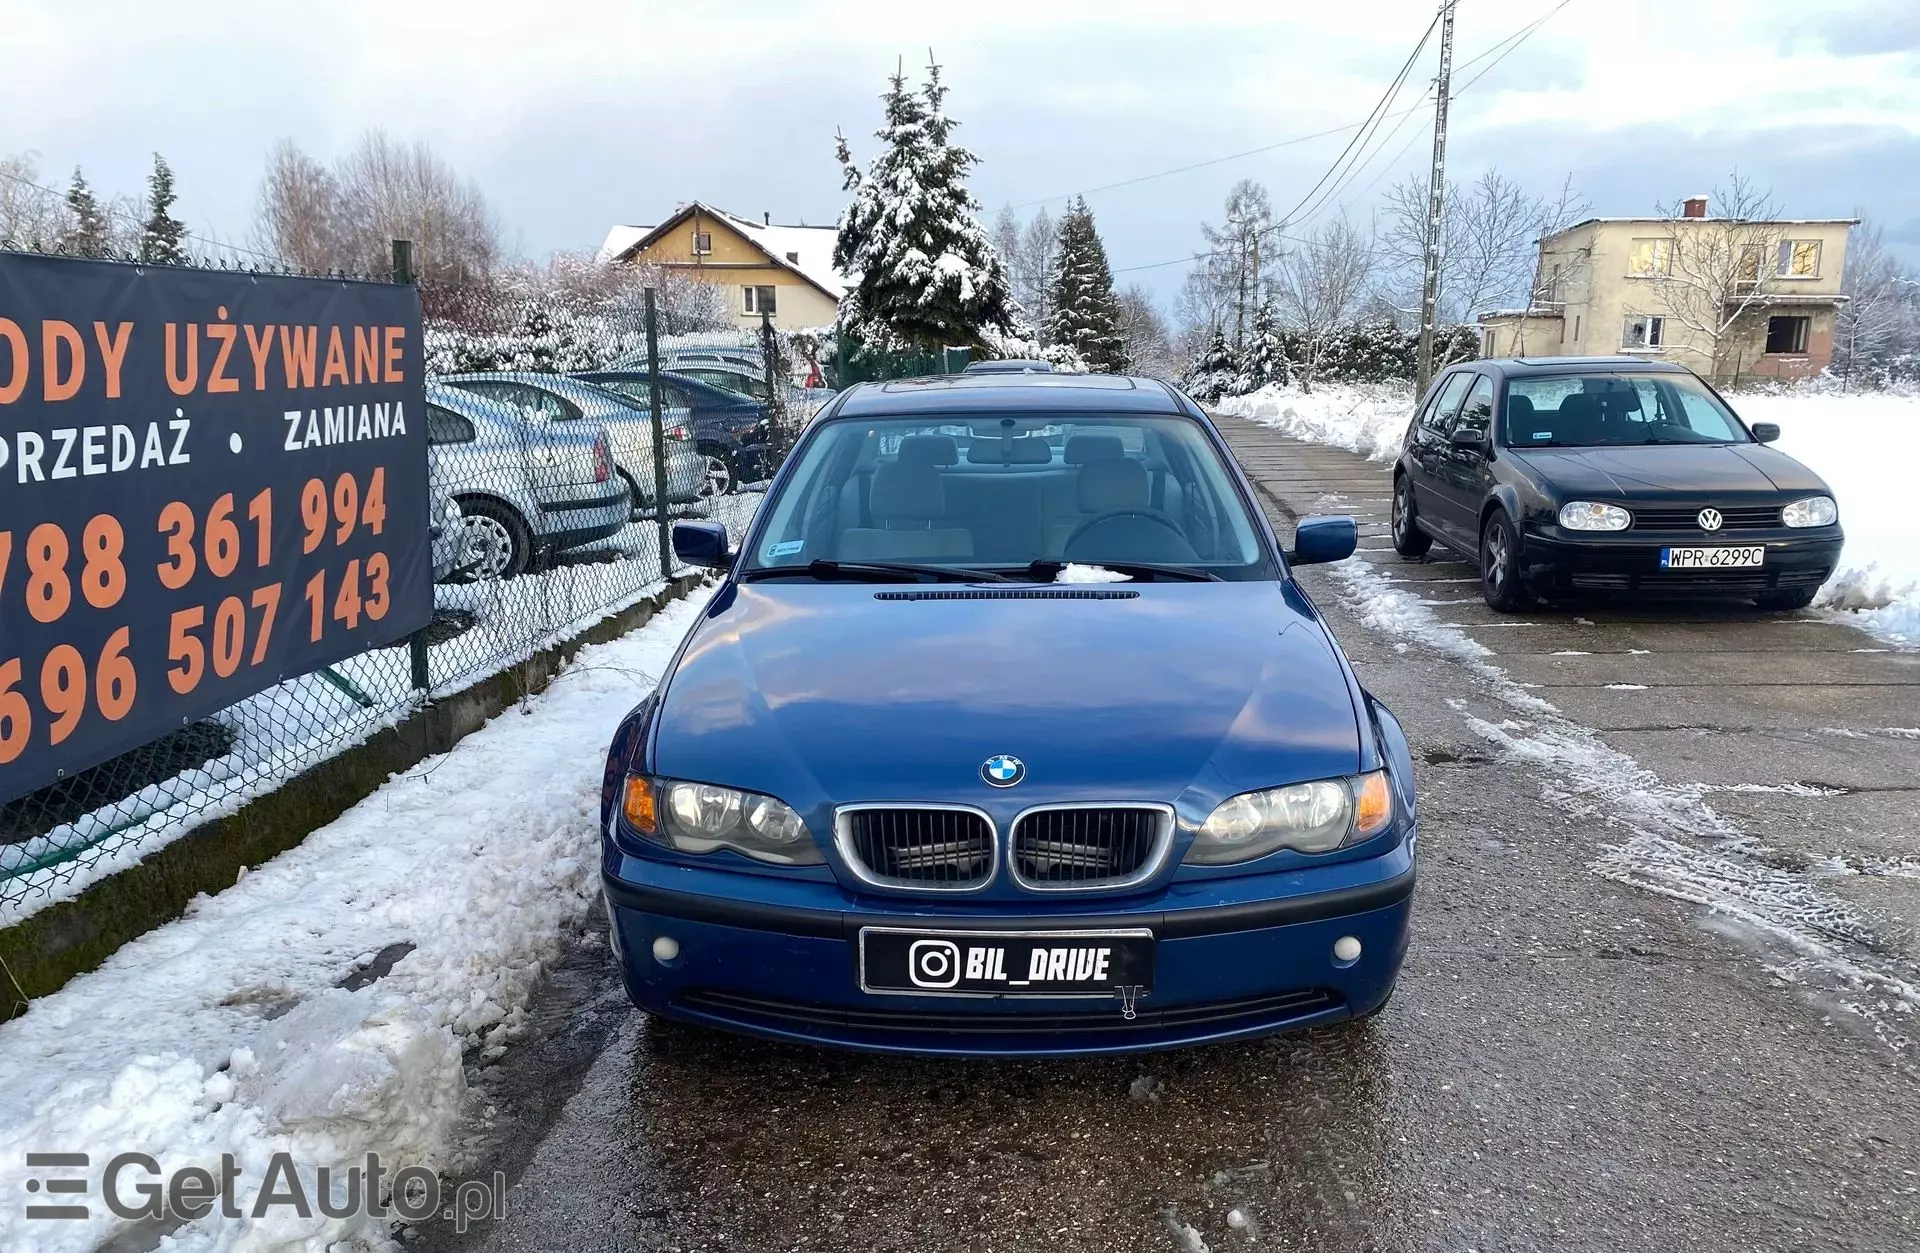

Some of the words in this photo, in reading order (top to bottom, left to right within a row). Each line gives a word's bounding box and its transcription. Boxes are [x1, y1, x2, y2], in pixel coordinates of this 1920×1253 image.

[165, 305, 405, 395] UŻYWANE
[284, 401, 406, 451] ZAMIANA
[157, 487, 272, 590] 361
[300, 467, 386, 555] 994
[1671, 549, 1705, 566] WPR
[1710, 548, 1762, 566] 6299C
[0, 625, 137, 764] 696
[168, 582, 282, 695] 507
[305, 552, 390, 643] 143
[985, 755, 1022, 765] BMW
[965, 947, 1111, 985] BIL_DRIVE
